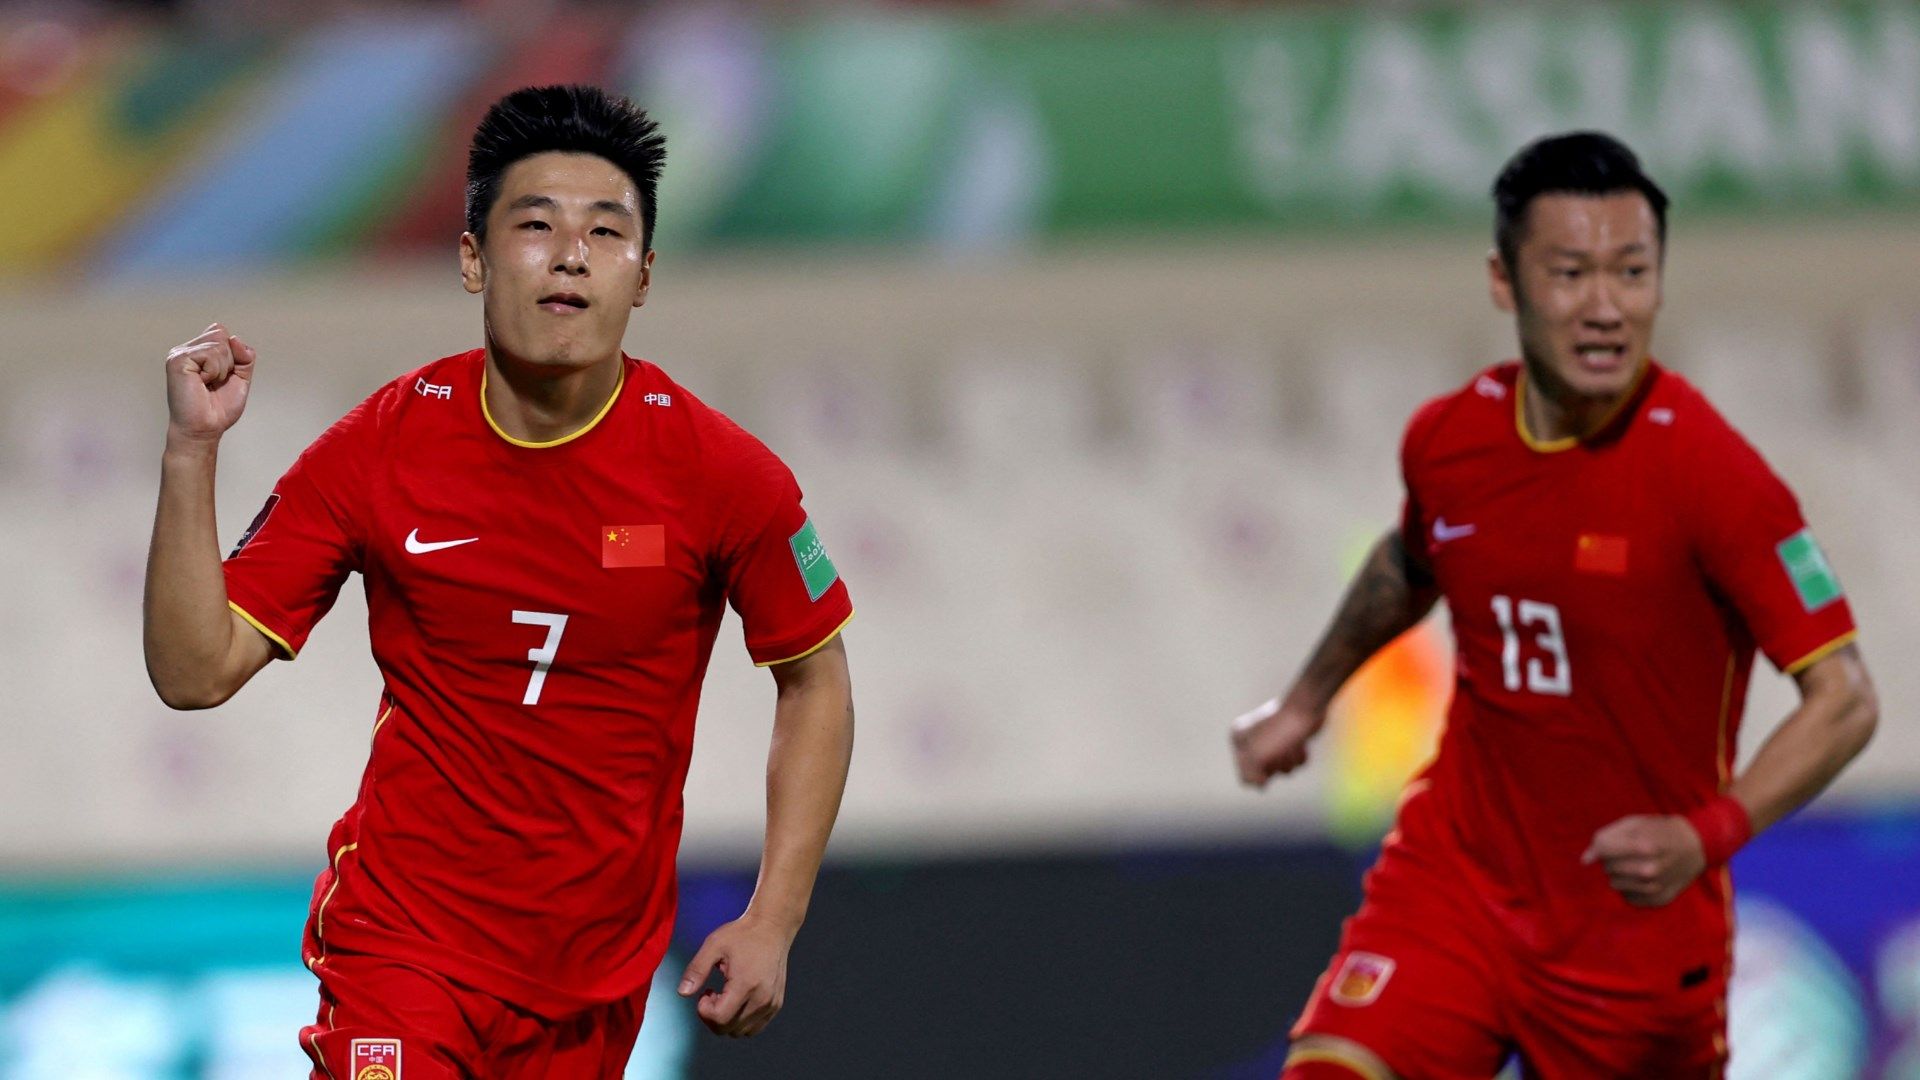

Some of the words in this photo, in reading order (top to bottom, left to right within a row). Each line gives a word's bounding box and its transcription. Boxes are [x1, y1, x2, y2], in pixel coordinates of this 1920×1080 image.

[415, 377, 452, 400] CFA
[644, 392, 671, 407] 中国
[1490, 594, 1573, 697] 13
[511, 609, 569, 706] 7
[357, 1044, 395, 1056] CFA
